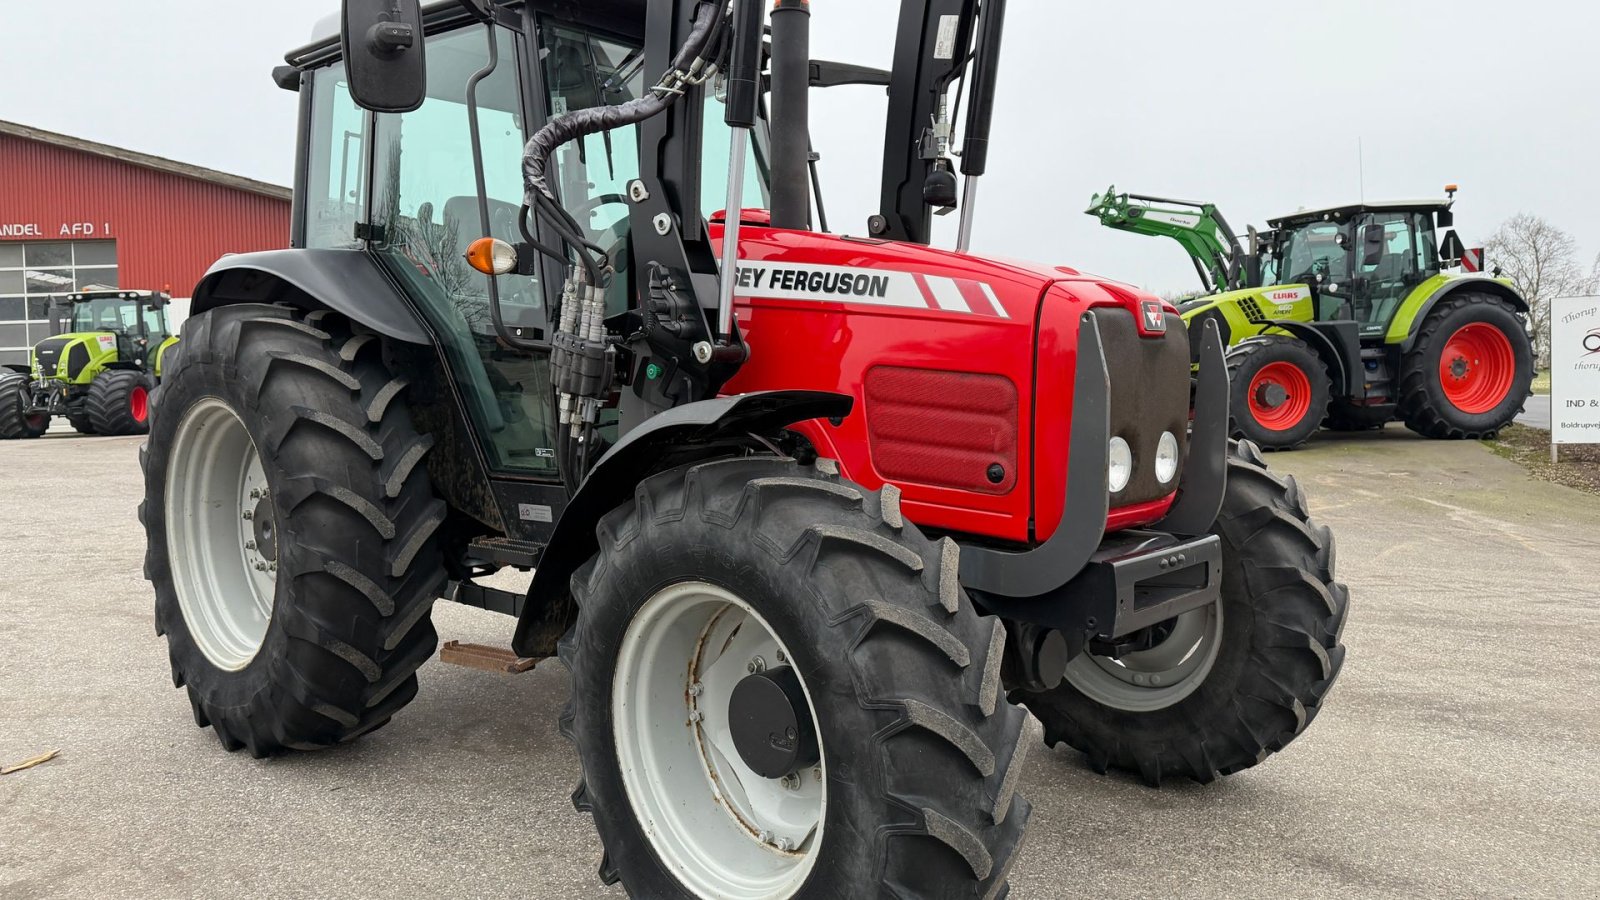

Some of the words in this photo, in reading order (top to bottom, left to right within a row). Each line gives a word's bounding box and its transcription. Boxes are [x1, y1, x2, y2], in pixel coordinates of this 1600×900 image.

[0, 224, 42, 236] NDEL
[60, 223, 94, 234] AFD
[769, 270, 888, 298] FERGUSON
[1561, 307, 1597, 324] Thorup
[1566, 400, 1586, 408] IND
